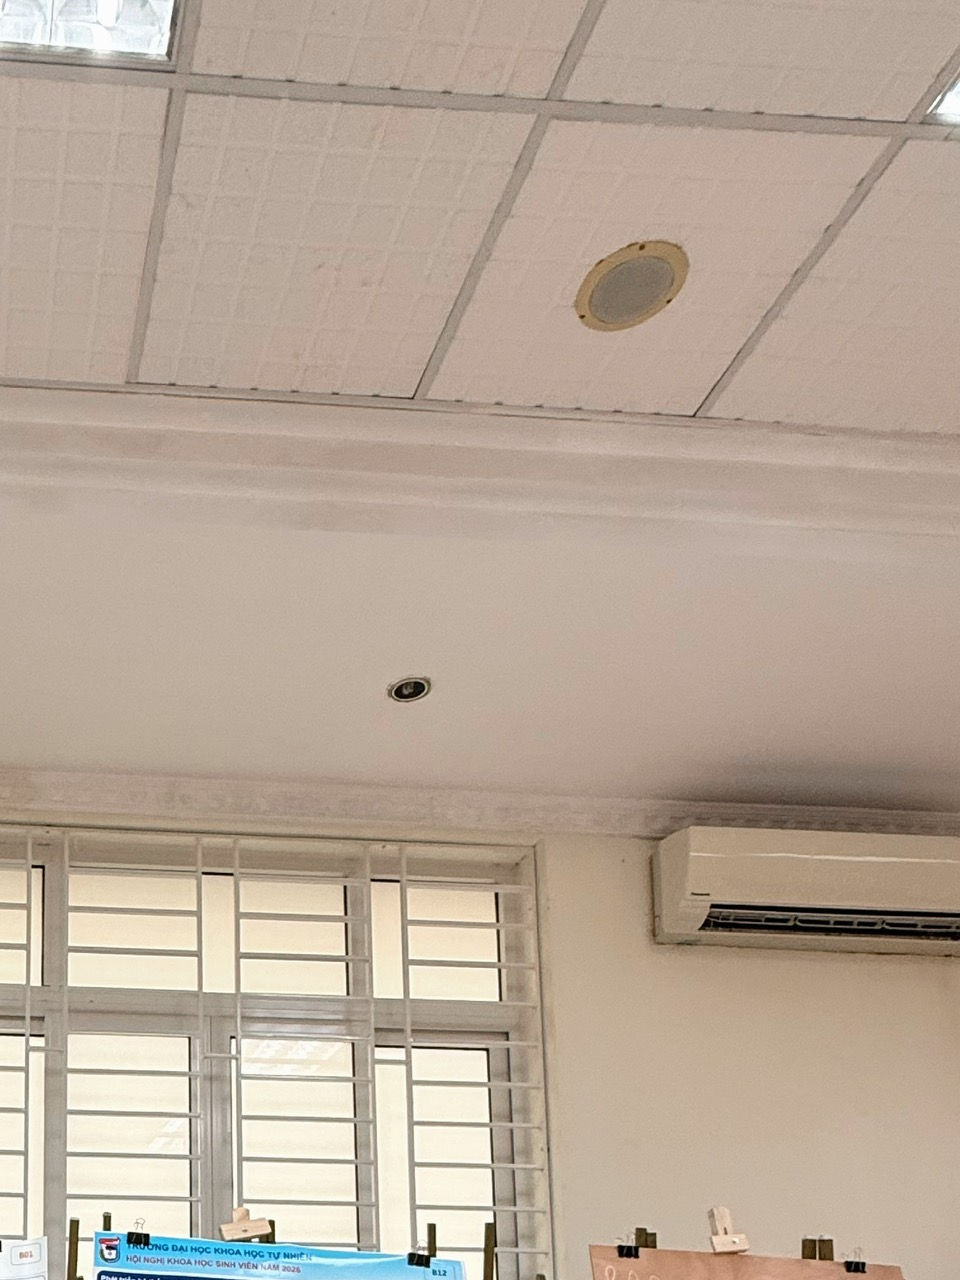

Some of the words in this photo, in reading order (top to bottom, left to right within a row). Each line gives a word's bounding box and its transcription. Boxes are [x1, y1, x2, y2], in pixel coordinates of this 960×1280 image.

[19, 1251, 33, 1259] B01
[172, 1243, 189, 1252] ĐẠI
[190, 1246, 212, 1255] HỌC
[214, 1247, 242, 1256] KHOA
[244, 1250, 265, 1259] HỌC
[267, 1251, 281, 1260] TỰ
[126, 1254, 141, 1264] HỘI
[143, 1256, 166, 1265] NGHỊ
[167, 1257, 192, 1265] KHOA
[194, 1259, 213, 1268] HỌC
[237, 1261, 258, 1270] VIÊN
[432, 1269, 447, 1277] B12
